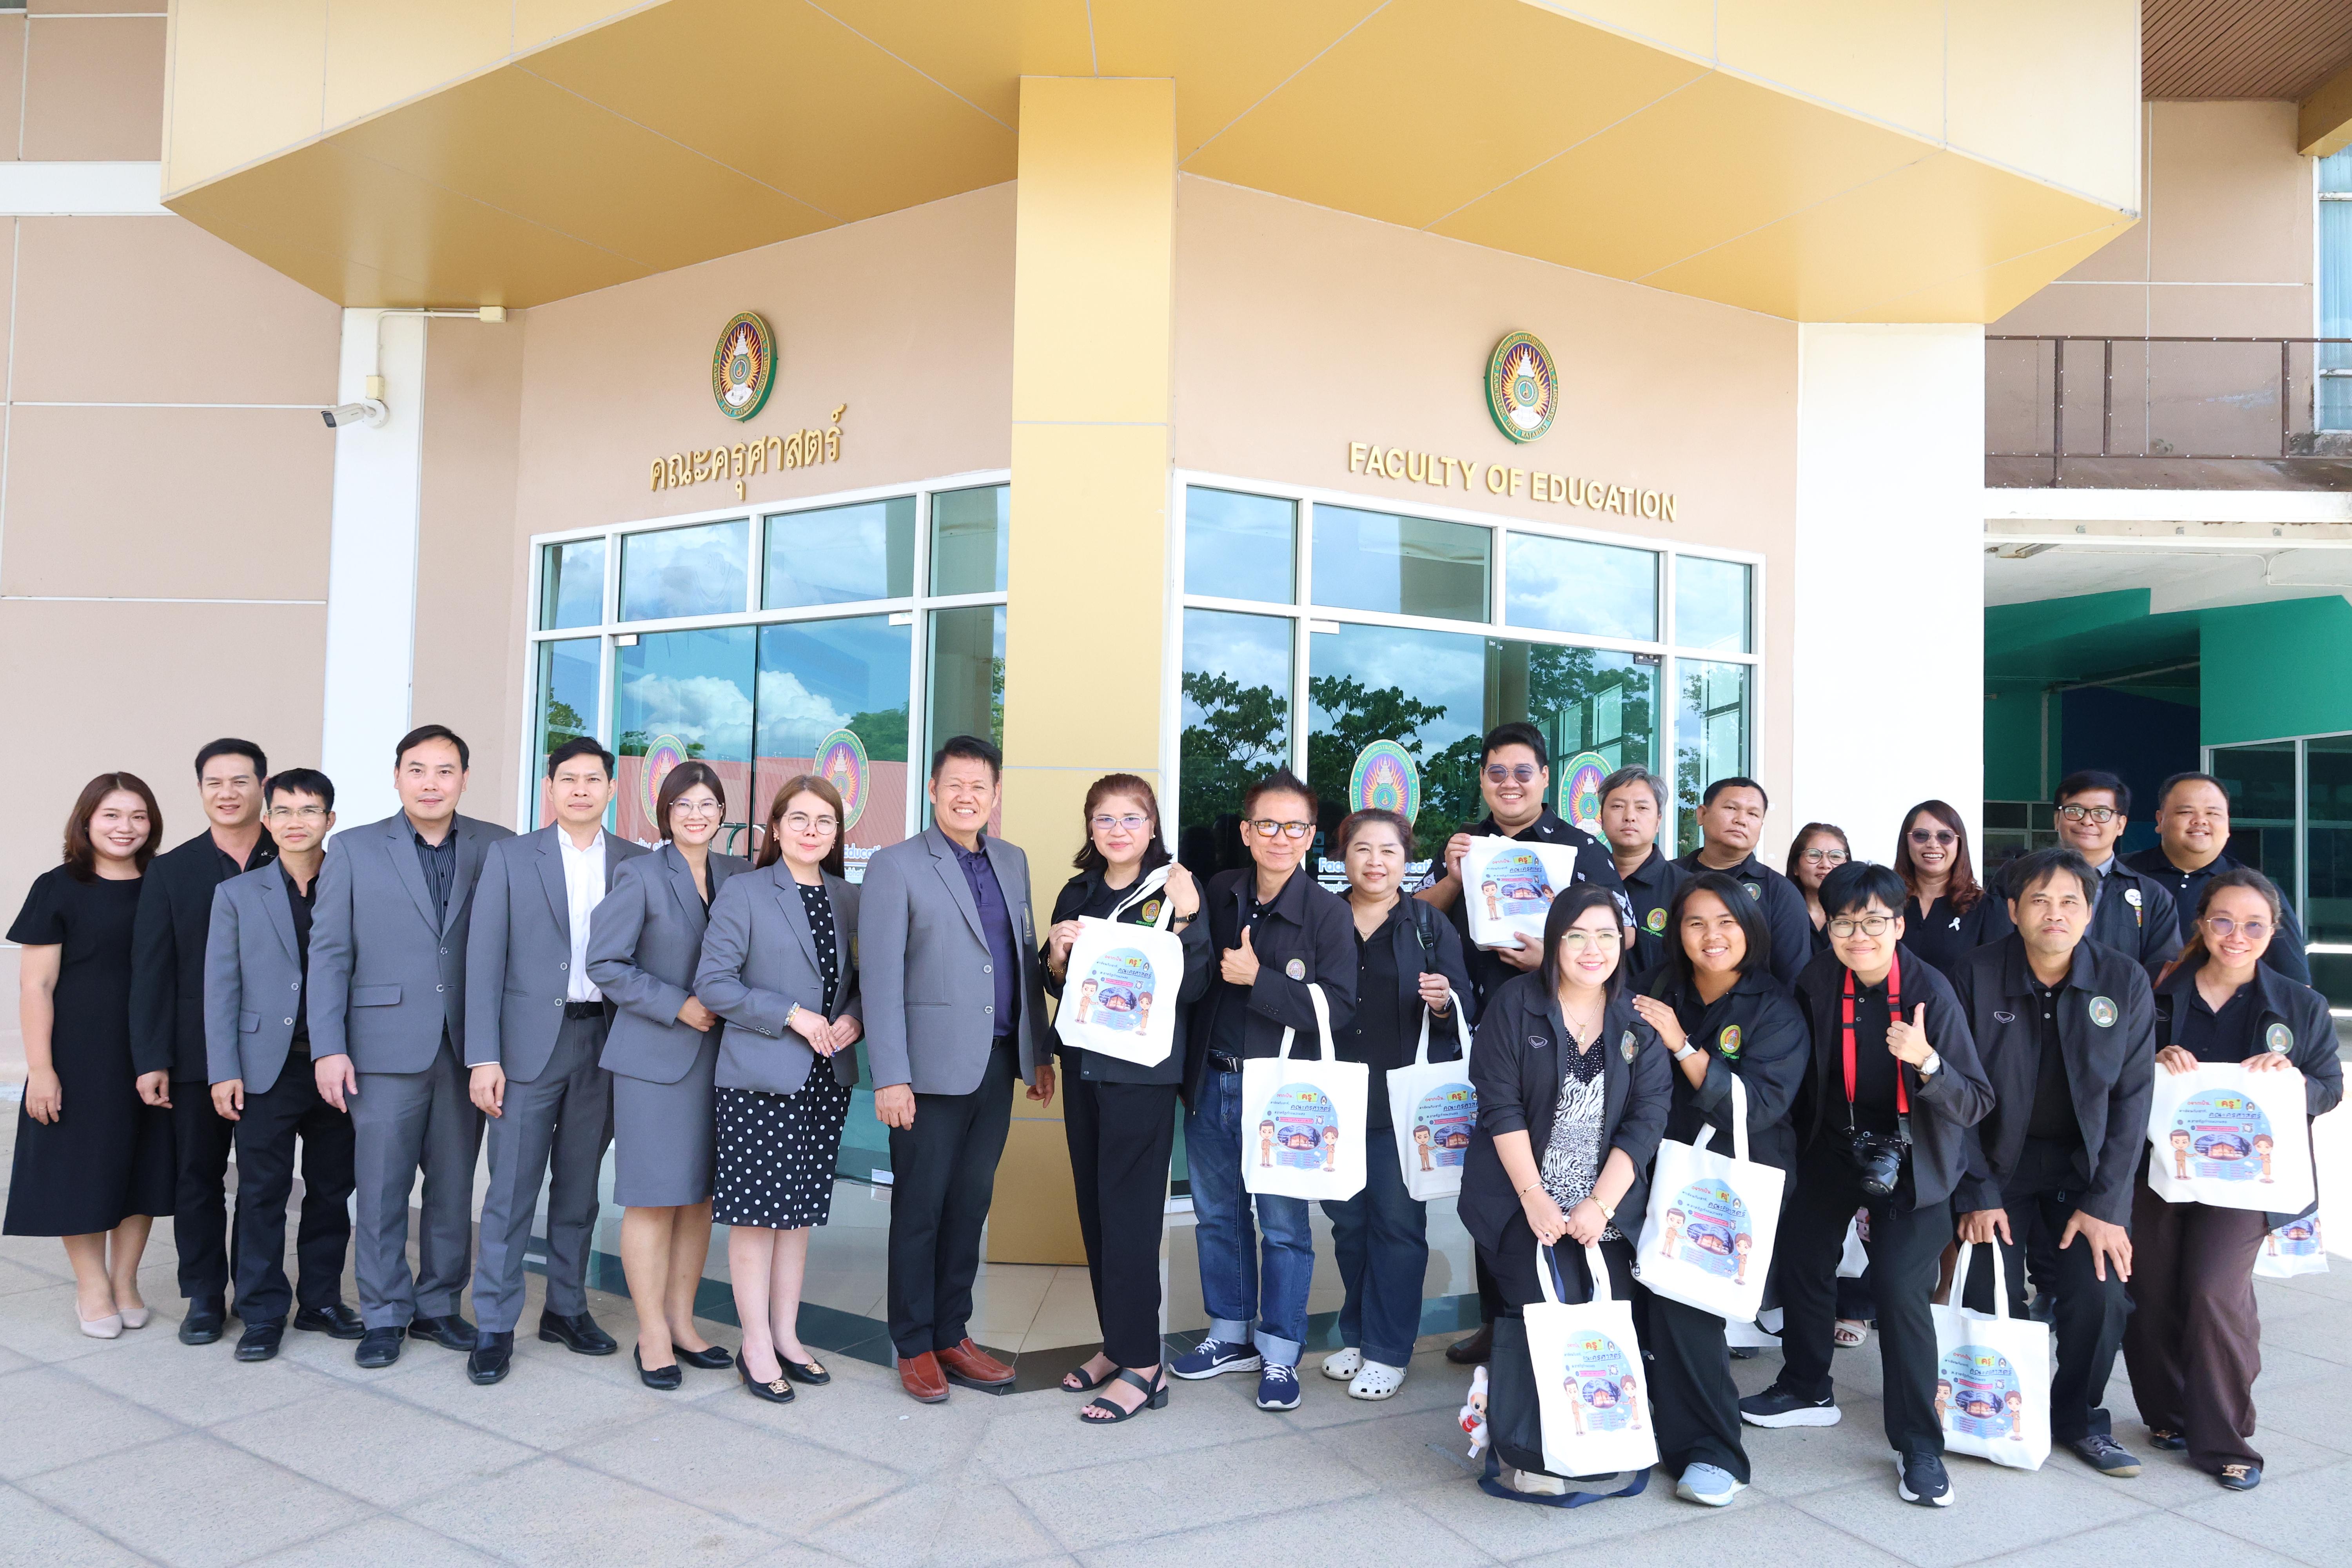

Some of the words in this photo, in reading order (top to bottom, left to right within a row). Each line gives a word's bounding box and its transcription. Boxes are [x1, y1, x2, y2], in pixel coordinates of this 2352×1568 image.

[1494, 372, 1507, 417] KAMPHAENG
[1505, 419, 1519, 434] PHET
[1520, 423, 1548, 440] RAJABHAT
[1546, 383, 1558, 421] UNIVERSITY
[650, 403, 847, 501] คณะครุศาสตร์
[1349, 441, 1478, 491] FACULTY
[1486, 464, 1524, 497] OF
[1531, 471, 1677, 522] EDUCATION
[1357, 744, 1414, 775] มหาวิทยาลัยราชภัฏกำแพงเพชร
[1129, 959, 1138, 967] ครู
[1118, 968, 1153, 978] คณะครุศาสตร์
[1301, 1094, 1312, 1102] ครู
[1452, 1093, 1462, 1101] ครู
[2221, 1101, 2234, 1109] ครู
[1585, 1341, 1598, 1351] ครู
[1981, 1358, 1991, 1367] ครู
